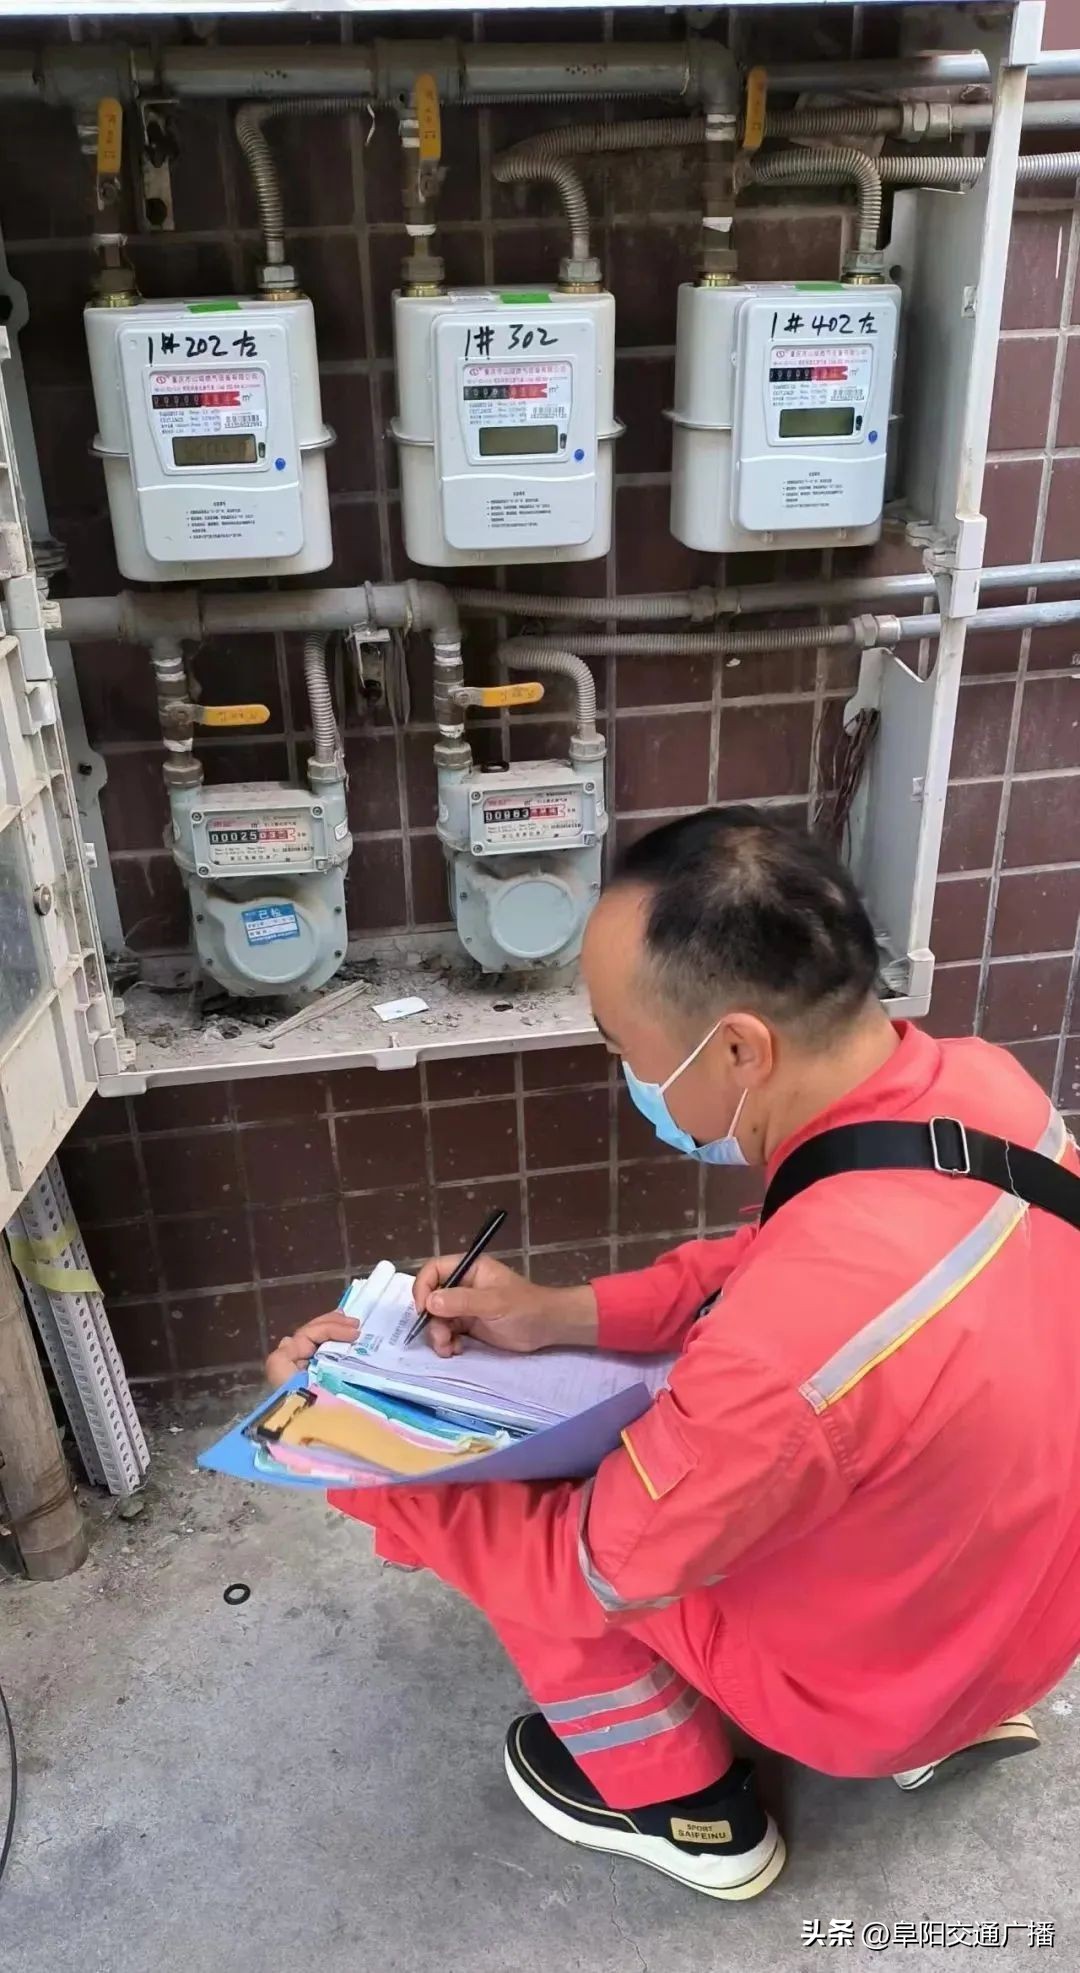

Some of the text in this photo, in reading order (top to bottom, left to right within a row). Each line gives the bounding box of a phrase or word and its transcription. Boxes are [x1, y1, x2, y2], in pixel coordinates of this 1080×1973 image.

[507, 324, 559, 350] 302
[687, 1823, 713, 1832] SPORT
[678, 1829, 726, 1840] SAIFEINU
